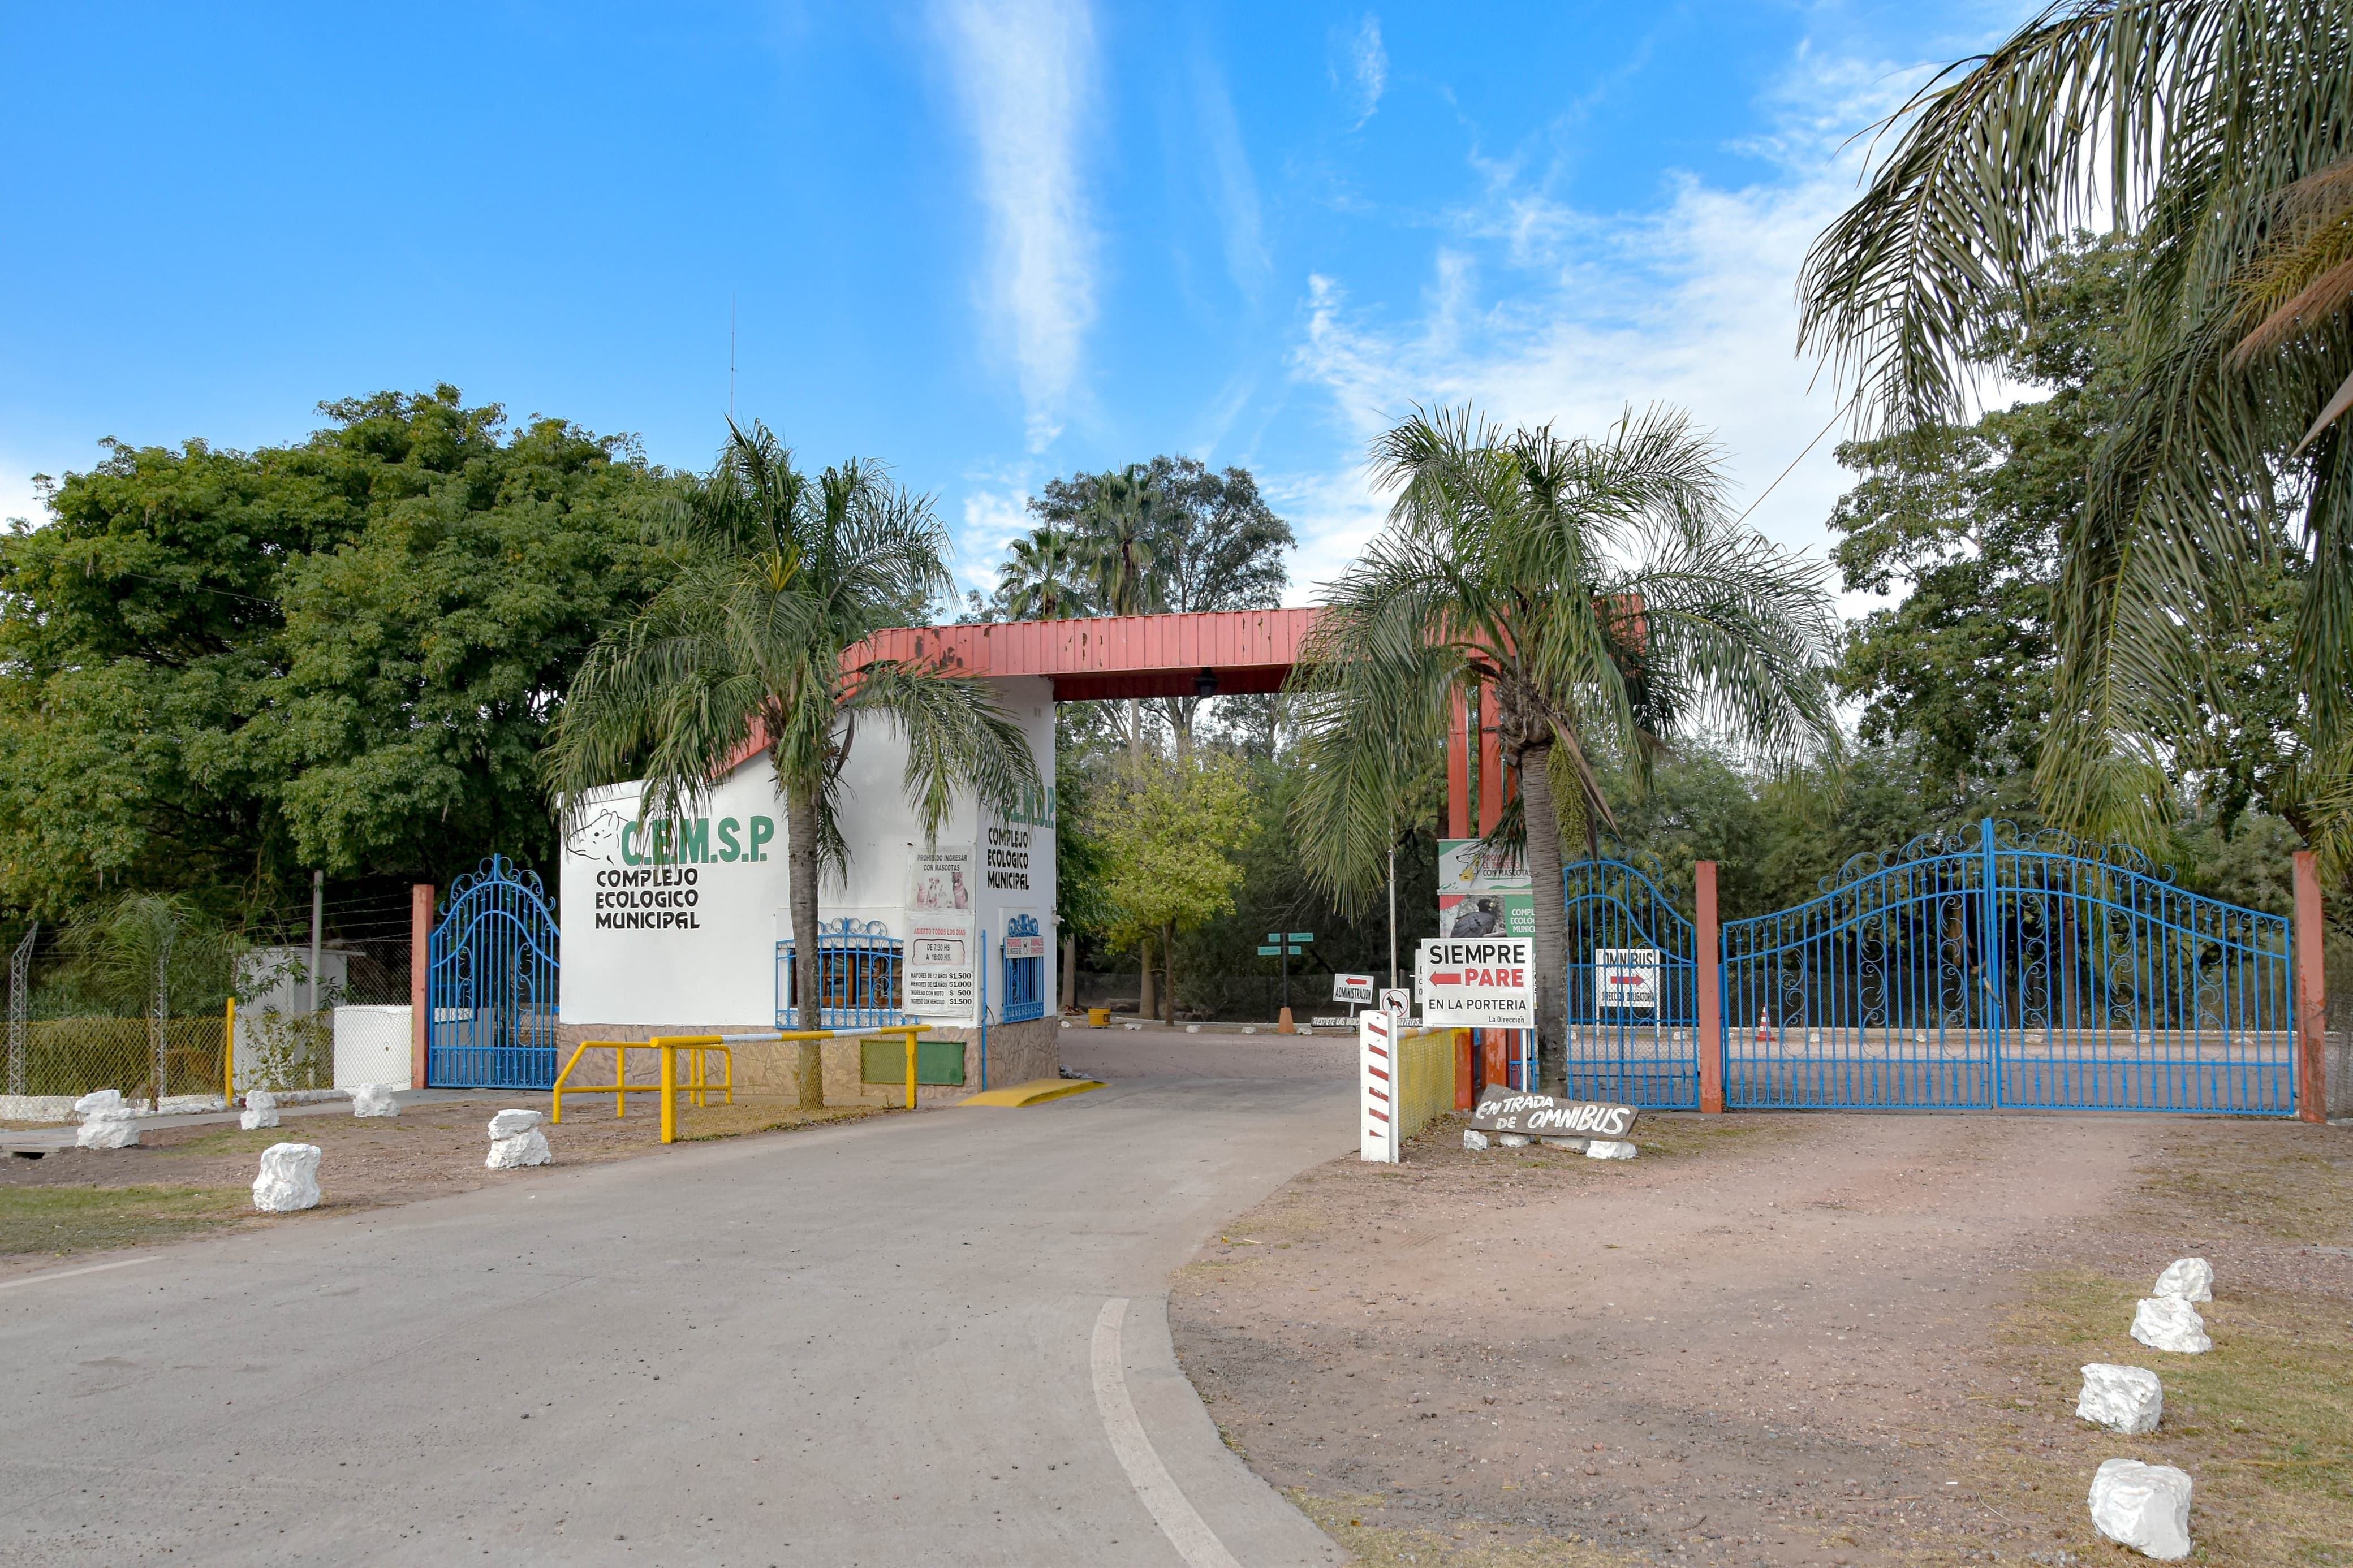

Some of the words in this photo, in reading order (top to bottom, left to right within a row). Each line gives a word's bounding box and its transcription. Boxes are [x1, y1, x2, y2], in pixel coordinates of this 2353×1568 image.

[622, 815, 774, 867] C.E.M.S.P.
[989, 827, 1028, 848] COMPLEJO
[988, 849, 1029, 869] ECOLOGICO
[596, 868, 698, 887] COMPLEJO
[988, 870, 1029, 891] MUNICIPAL
[596, 889, 699, 909] ECOLOGICO
[595, 912, 700, 930] MUNICIPAL
[1430, 944, 1525, 964] SIEMPRE
[1604, 952, 1653, 969] MNBUS
[1465, 969, 1524, 987] PARE
[1335, 986, 1371, 1000] ADMINISTRACION
[1627, 992, 1654, 1002] OLIGATORIA
[1429, 999, 1444, 1009] EN
[1448, 999, 1463, 1009] LA
[1467, 999, 1527, 1010] PORTERIA
[1313, 1017, 1335, 1025] RESPETE
[1497, 1015, 1524, 1023] Dirección
[1476, 1095, 1554, 1120] ENTRADA
[1496, 1116, 1516, 1129] DE
[1527, 1104, 1630, 1134] OMNIBUS
